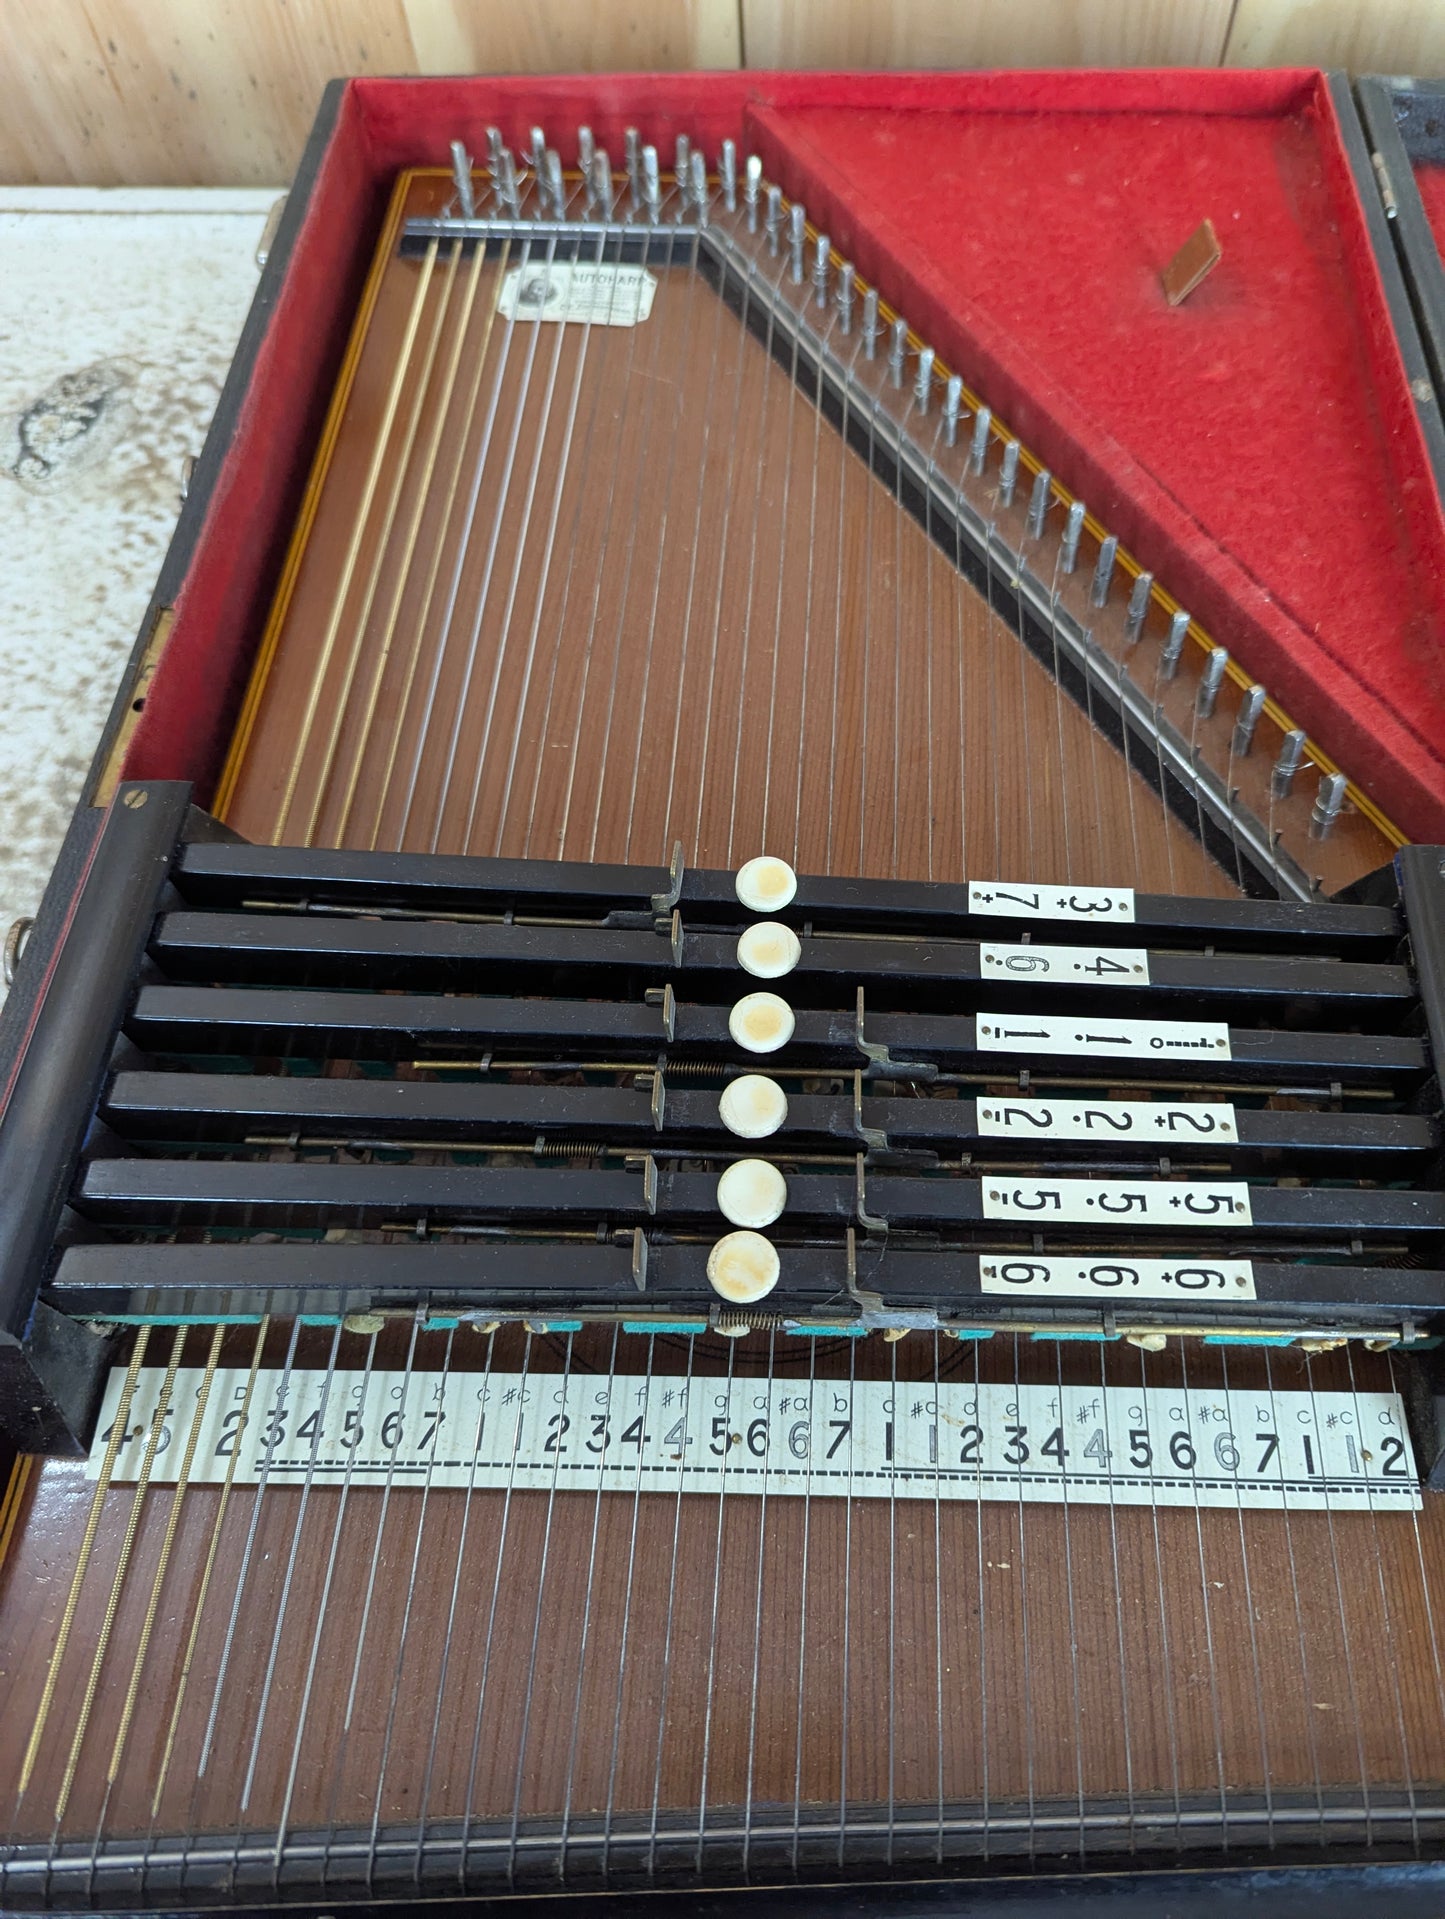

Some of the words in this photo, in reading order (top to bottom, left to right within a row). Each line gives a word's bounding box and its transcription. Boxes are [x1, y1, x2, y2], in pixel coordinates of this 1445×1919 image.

[234, 1386, 250, 1400] D
[215, 1409, 249, 1456] 2
[260, 1410, 289, 1448] 3
[296, 1409, 325, 1449] 4
[340, 1410, 365, 1449] 5
[381, 1410, 406, 1449] 6
[417, 1411, 446, 1450] 7
[476, 1412, 486, 1450] 1
[544, 1414, 571, 1453] 2
[585, 1414, 612, 1454] 3
[620, 1415, 651, 1454] 4
[664, 1416, 693, 1455] 4
[709, 1417, 733, 1456] 5
[747, 1418, 771, 1457] 6
[788, 1420, 811, 1460] 6
[826, 1420, 852, 1459] 7
[885, 1422, 894, 1461] 1
[960, 1425, 985, 1464] 2
[1003, 1426, 1030, 1465] 3
[1040, 1427, 1070, 1467] 4
[1083, 1428, 1113, 1468] 4
[1129, 1429, 1153, 1469] 5
[1169, 1431, 1197, 1471] 6
[1213, 1432, 1240, 1472] 6
[1255, 1433, 1280, 1473] 7
[1302, 1434, 1315, 1475] 1
[1380, 1436, 1407, 1476] 2
